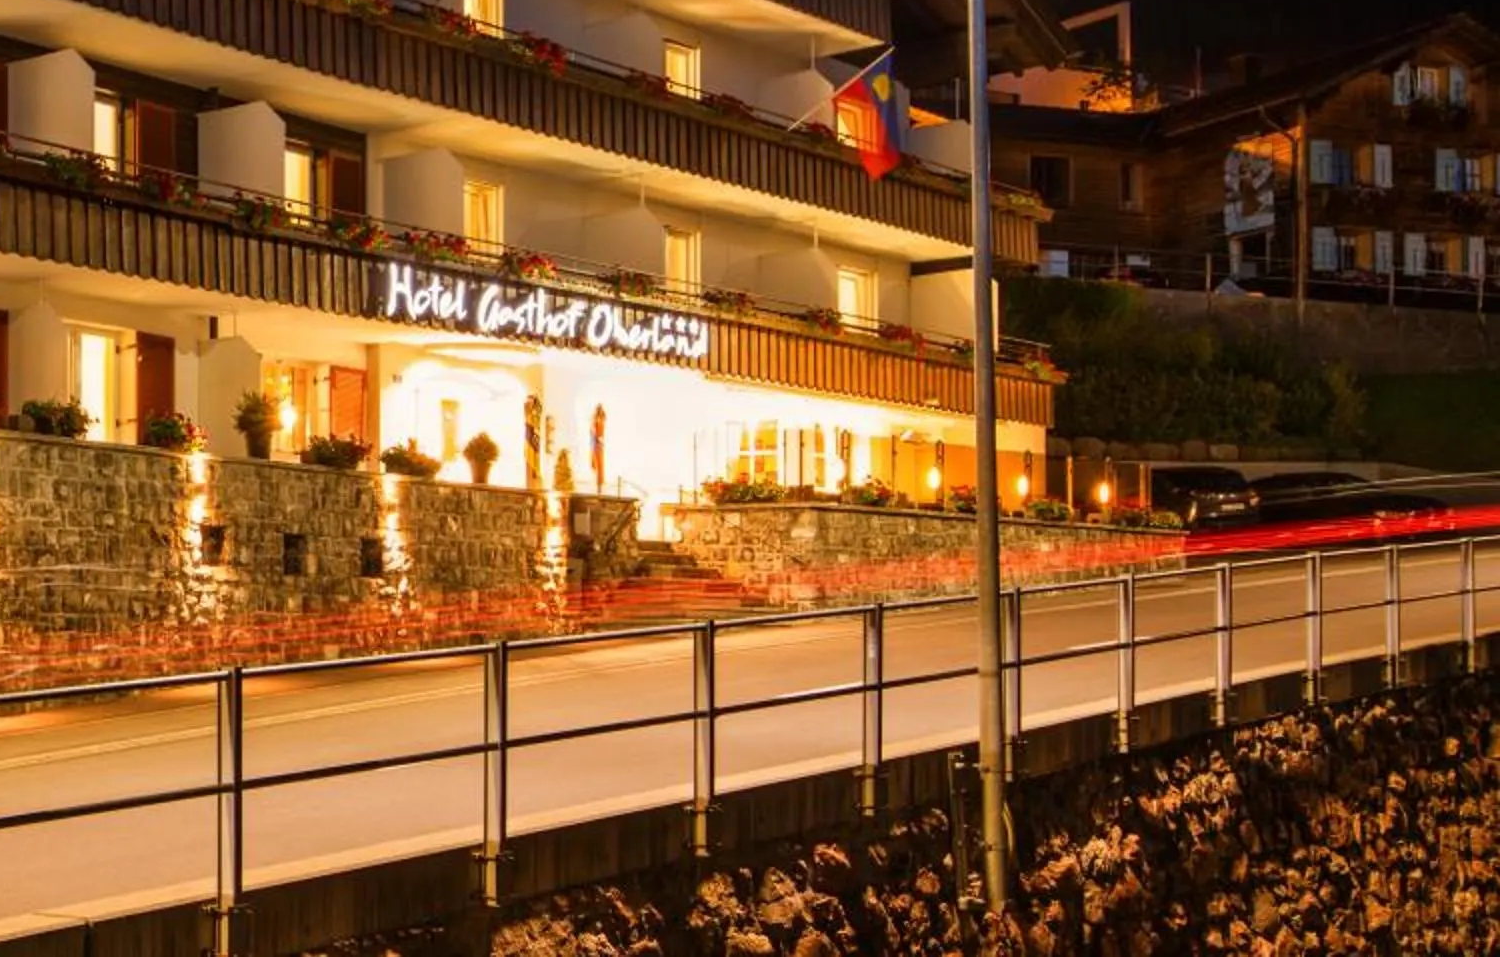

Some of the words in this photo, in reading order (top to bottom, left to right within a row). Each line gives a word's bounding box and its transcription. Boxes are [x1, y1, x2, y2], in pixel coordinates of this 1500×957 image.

[386, 261, 468, 322] Hotel
[477, 283, 587, 338] Gasthof
[587, 302, 708, 358] Oberland
